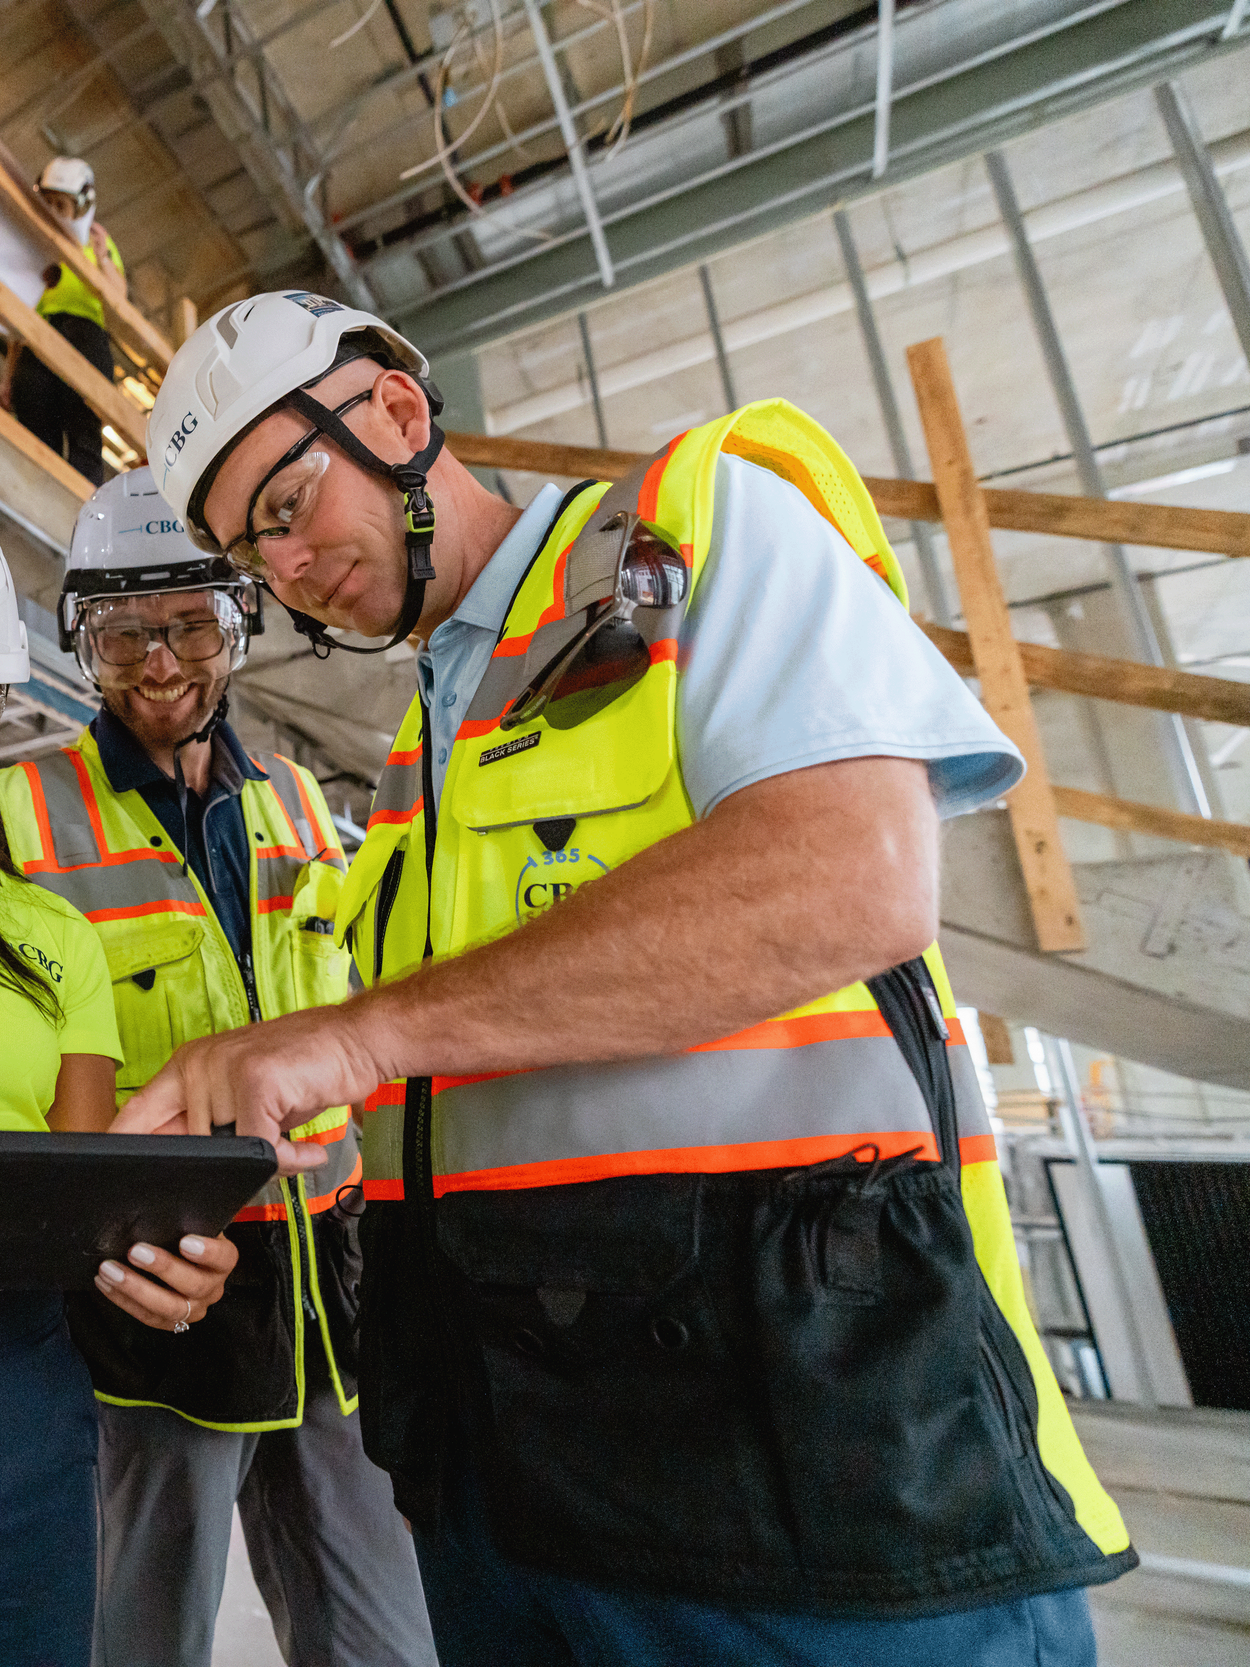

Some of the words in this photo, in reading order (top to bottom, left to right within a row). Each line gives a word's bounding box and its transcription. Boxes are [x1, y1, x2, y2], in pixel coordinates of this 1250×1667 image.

[165, 411, 198, 467] CBG
[146, 520, 185, 535] CBG
[480, 750, 505, 763] BLACK
[542, 848, 580, 865] 365
[524, 883, 574, 908] CB
[18, 943, 63, 983] CBG
